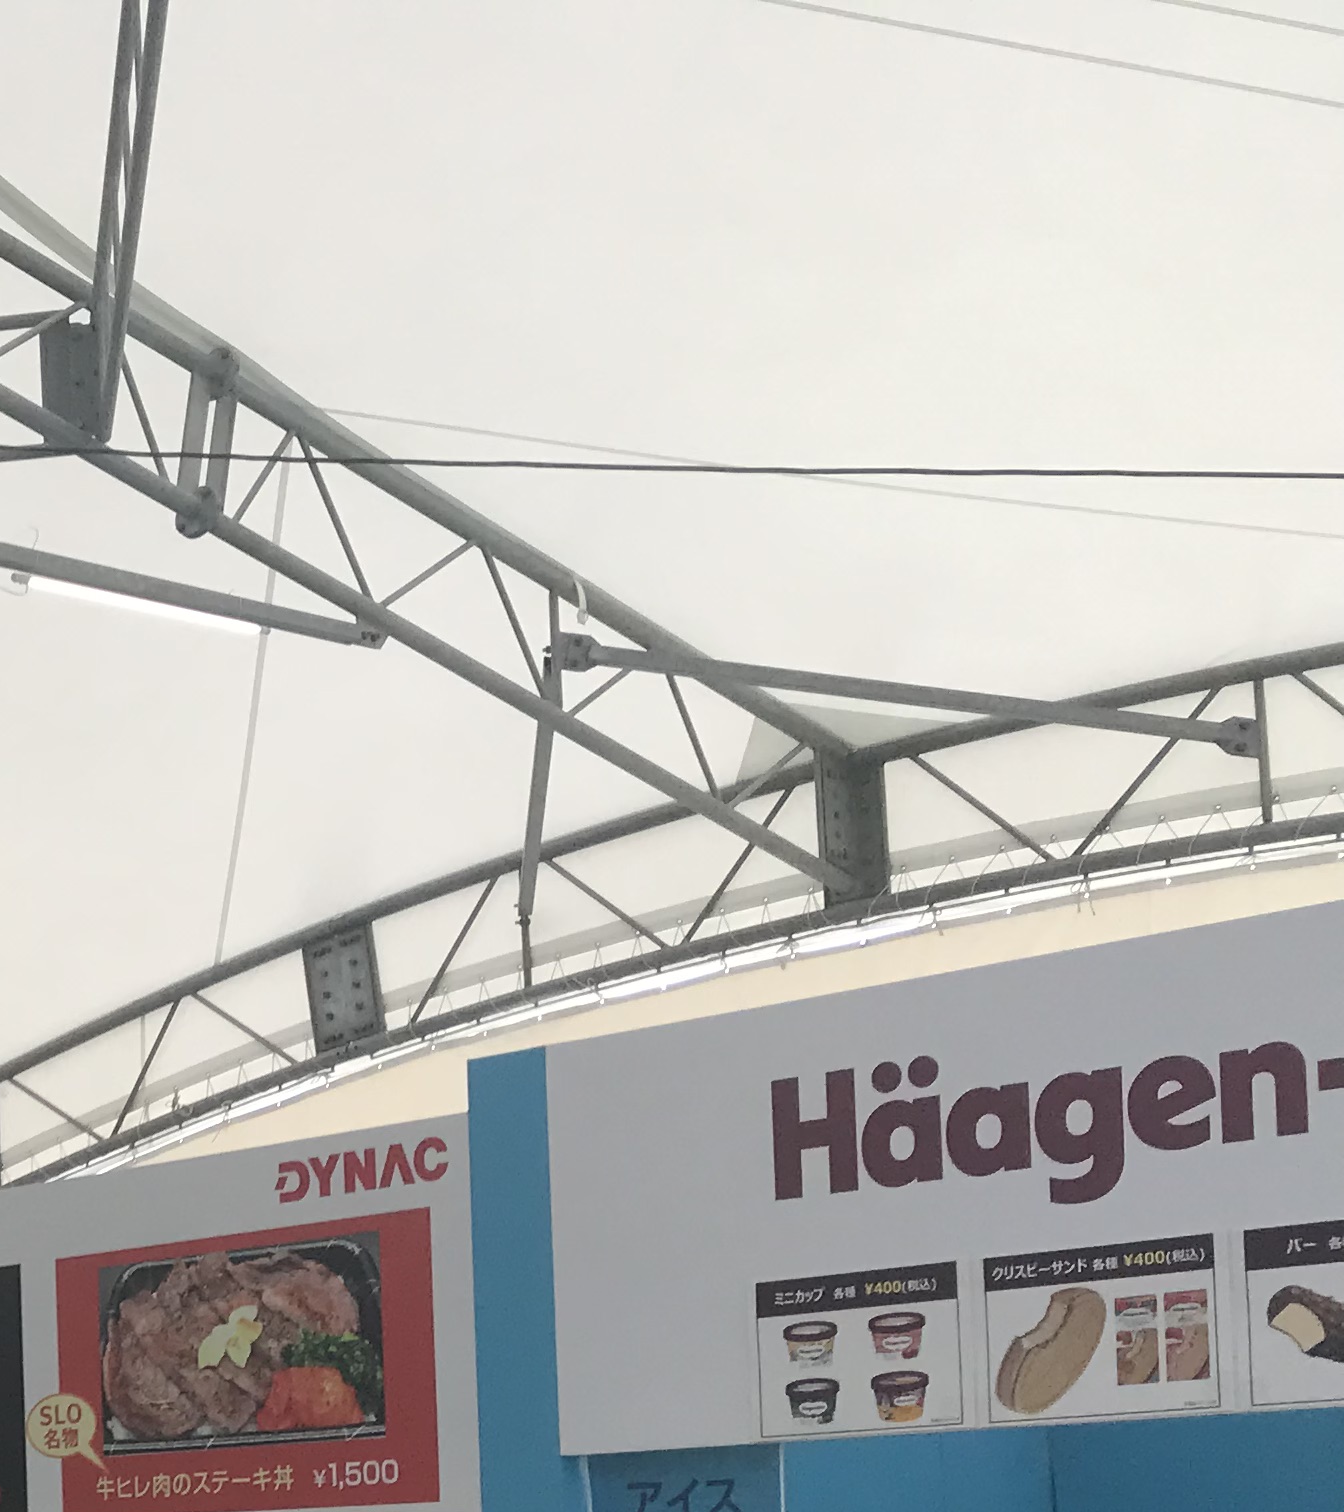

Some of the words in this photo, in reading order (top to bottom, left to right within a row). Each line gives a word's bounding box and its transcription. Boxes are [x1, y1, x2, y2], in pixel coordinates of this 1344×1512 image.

[273, 1136, 450, 1204] DYNAC
[1286, 1237, 1317, 1255] バー
[992, 1259, 1088, 1282] クリスピーサンド
[1092, 1257, 1118, 1272] 各種
[1124, 1247, 1206, 1267] ¥400(税込)
[774, 1286, 825, 1306] ミニカップ
[833, 1286, 856, 1301] 各種
[864, 1277, 938, 1296] ¥400(税込)
[38, 1403, 83, 1427] SLO
[43, 1427, 80, 1450] 名物
[96, 1463, 295, 1502] 牛ヒレ肉のステーキ丼
[313, 1458, 400, 1492] ¥1,500
